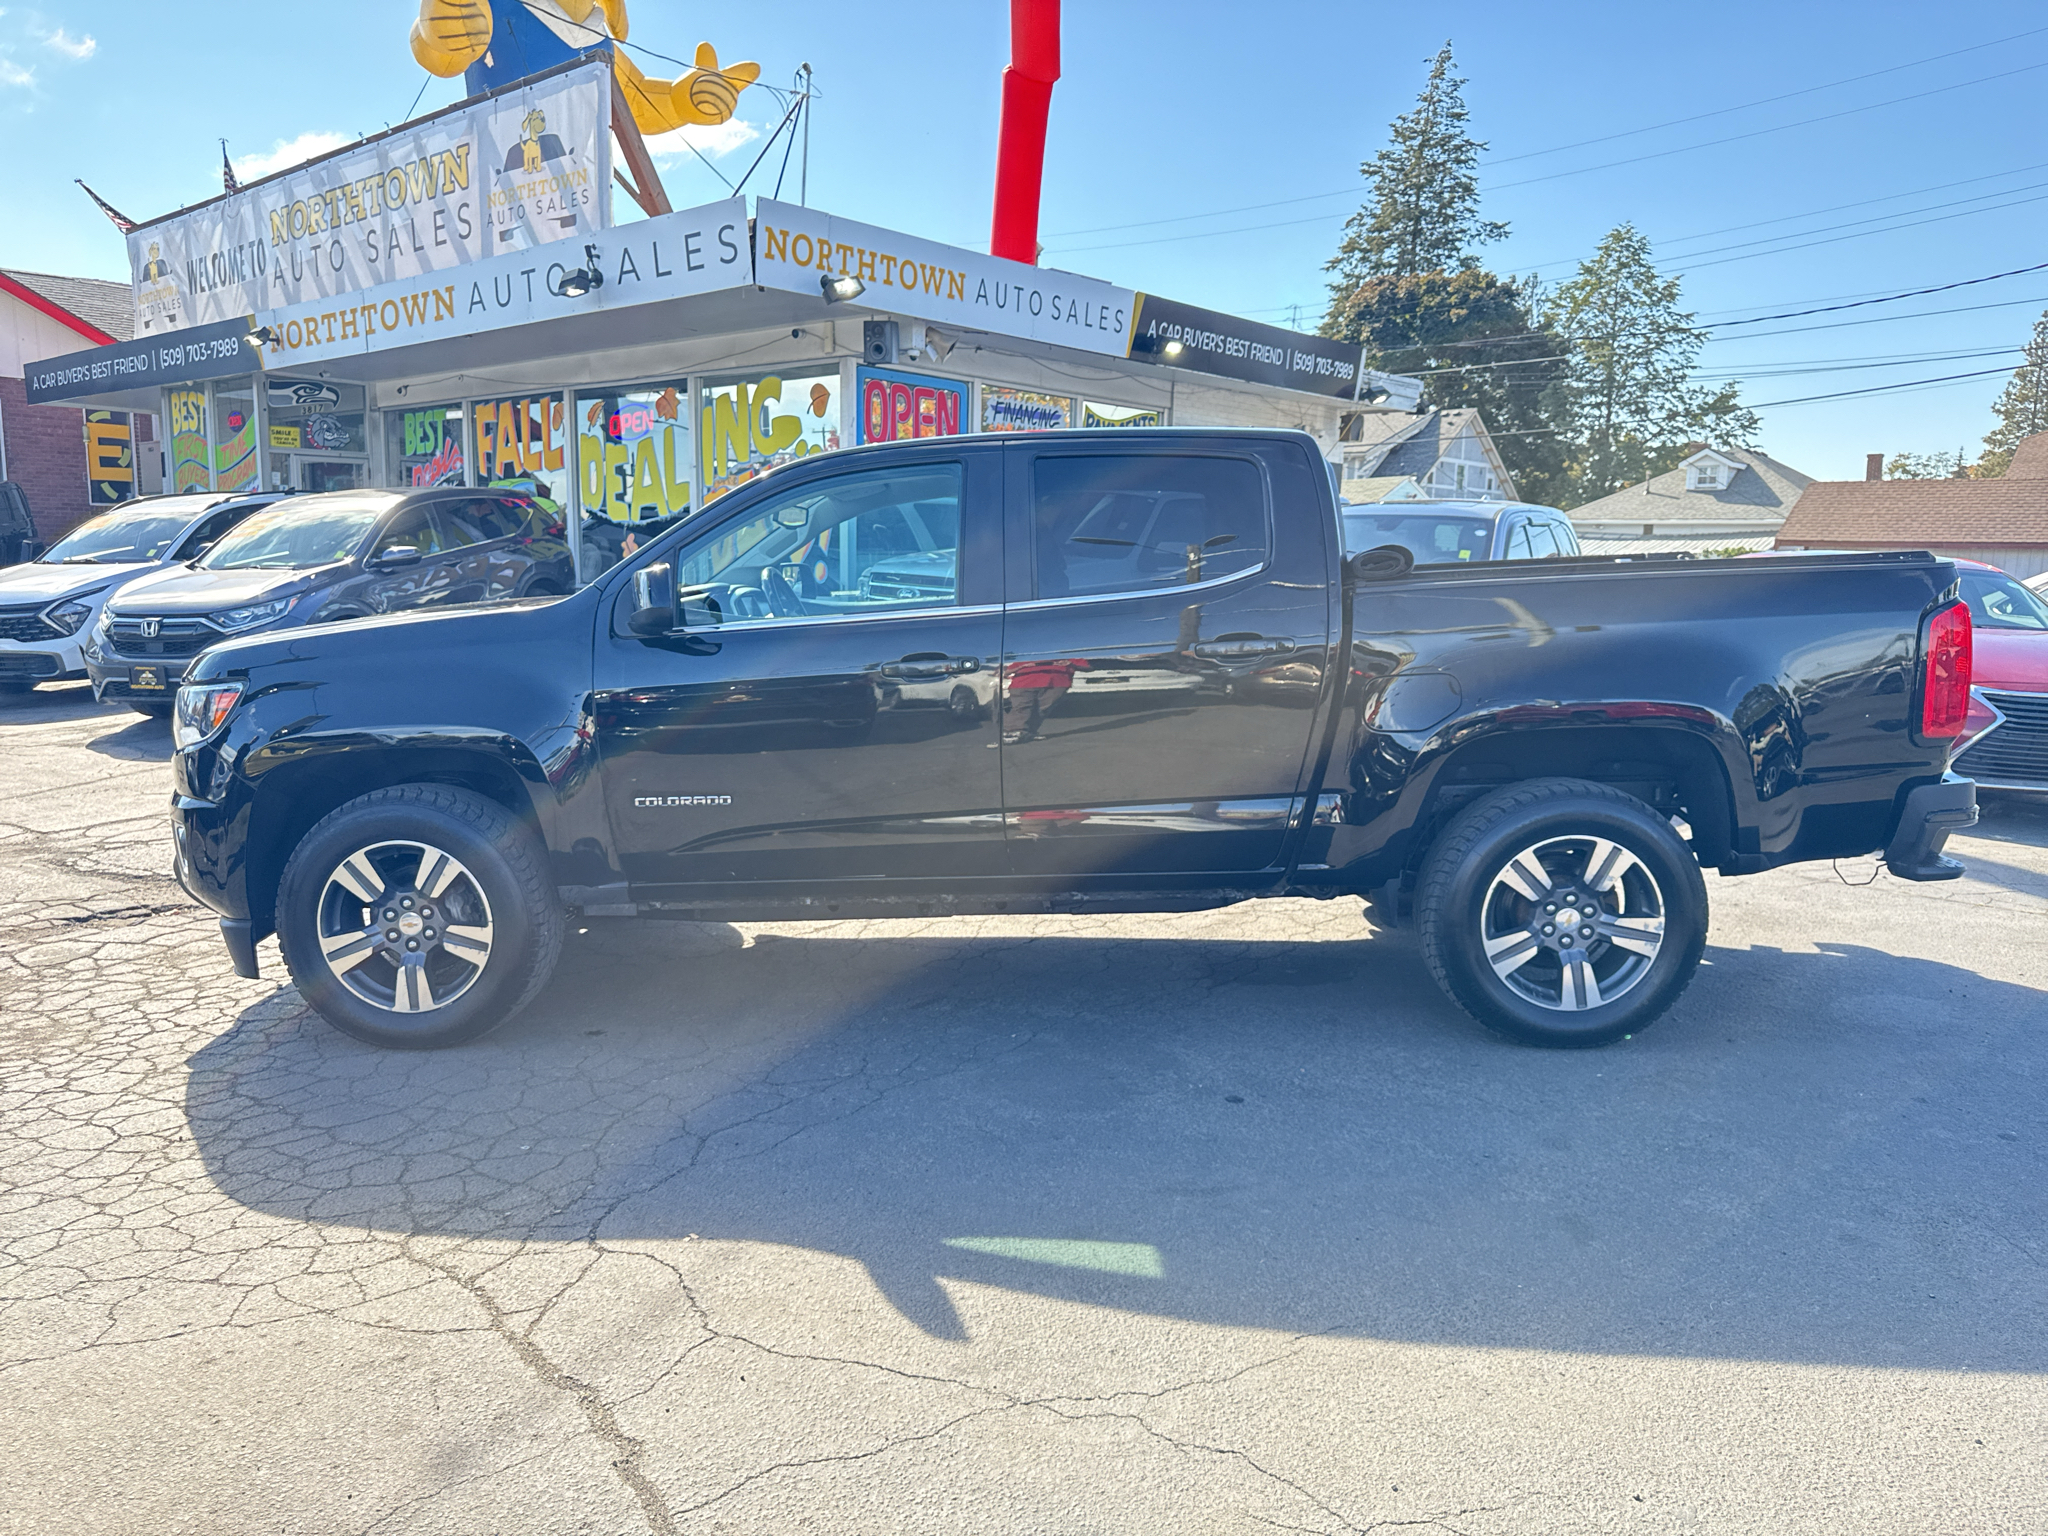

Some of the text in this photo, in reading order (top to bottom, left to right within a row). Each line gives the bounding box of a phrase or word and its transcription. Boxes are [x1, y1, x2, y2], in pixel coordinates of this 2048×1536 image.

[269, 143, 470, 248] NORTHTOWN
[486, 168, 589, 209] NORTHTOWN
[486, 188, 589, 228] AUTO SALES
[186, 237, 267, 295] WELCOME TO
[273, 202, 472, 288] AUTO SALES
[158, 297, 182, 313] SALES
[764, 226, 1124, 334] NORTHTOWN AUTO SALES
[267, 284, 455, 353] NORTHTOWN
[468, 262, 566, 314] AUTO
[33, 336, 239, 390] A CAR BUYER'S BEST FRIEND (509) 703-7989
[1147, 319, 1157, 339] A
[1183, 326, 1224, 355] BUYER'S
[1225, 337, 1251, 359] BEST
[1250, 343, 1283, 366] FRIEND
[1292, 351, 1315, 374] (509)
[1315, 357, 1354, 380] 703-7989
[171, 391, 206, 437] BEST
[302, 404, 323, 415] 3817
[404, 408, 447, 456] BEST
[609, 409, 654, 437] OPEN
[864, 379, 960, 443] OPEN
[993, 401, 1061, 428] FINANCING
[475, 395, 565, 478] FALL
[634, 795, 732, 807] COLORADO
